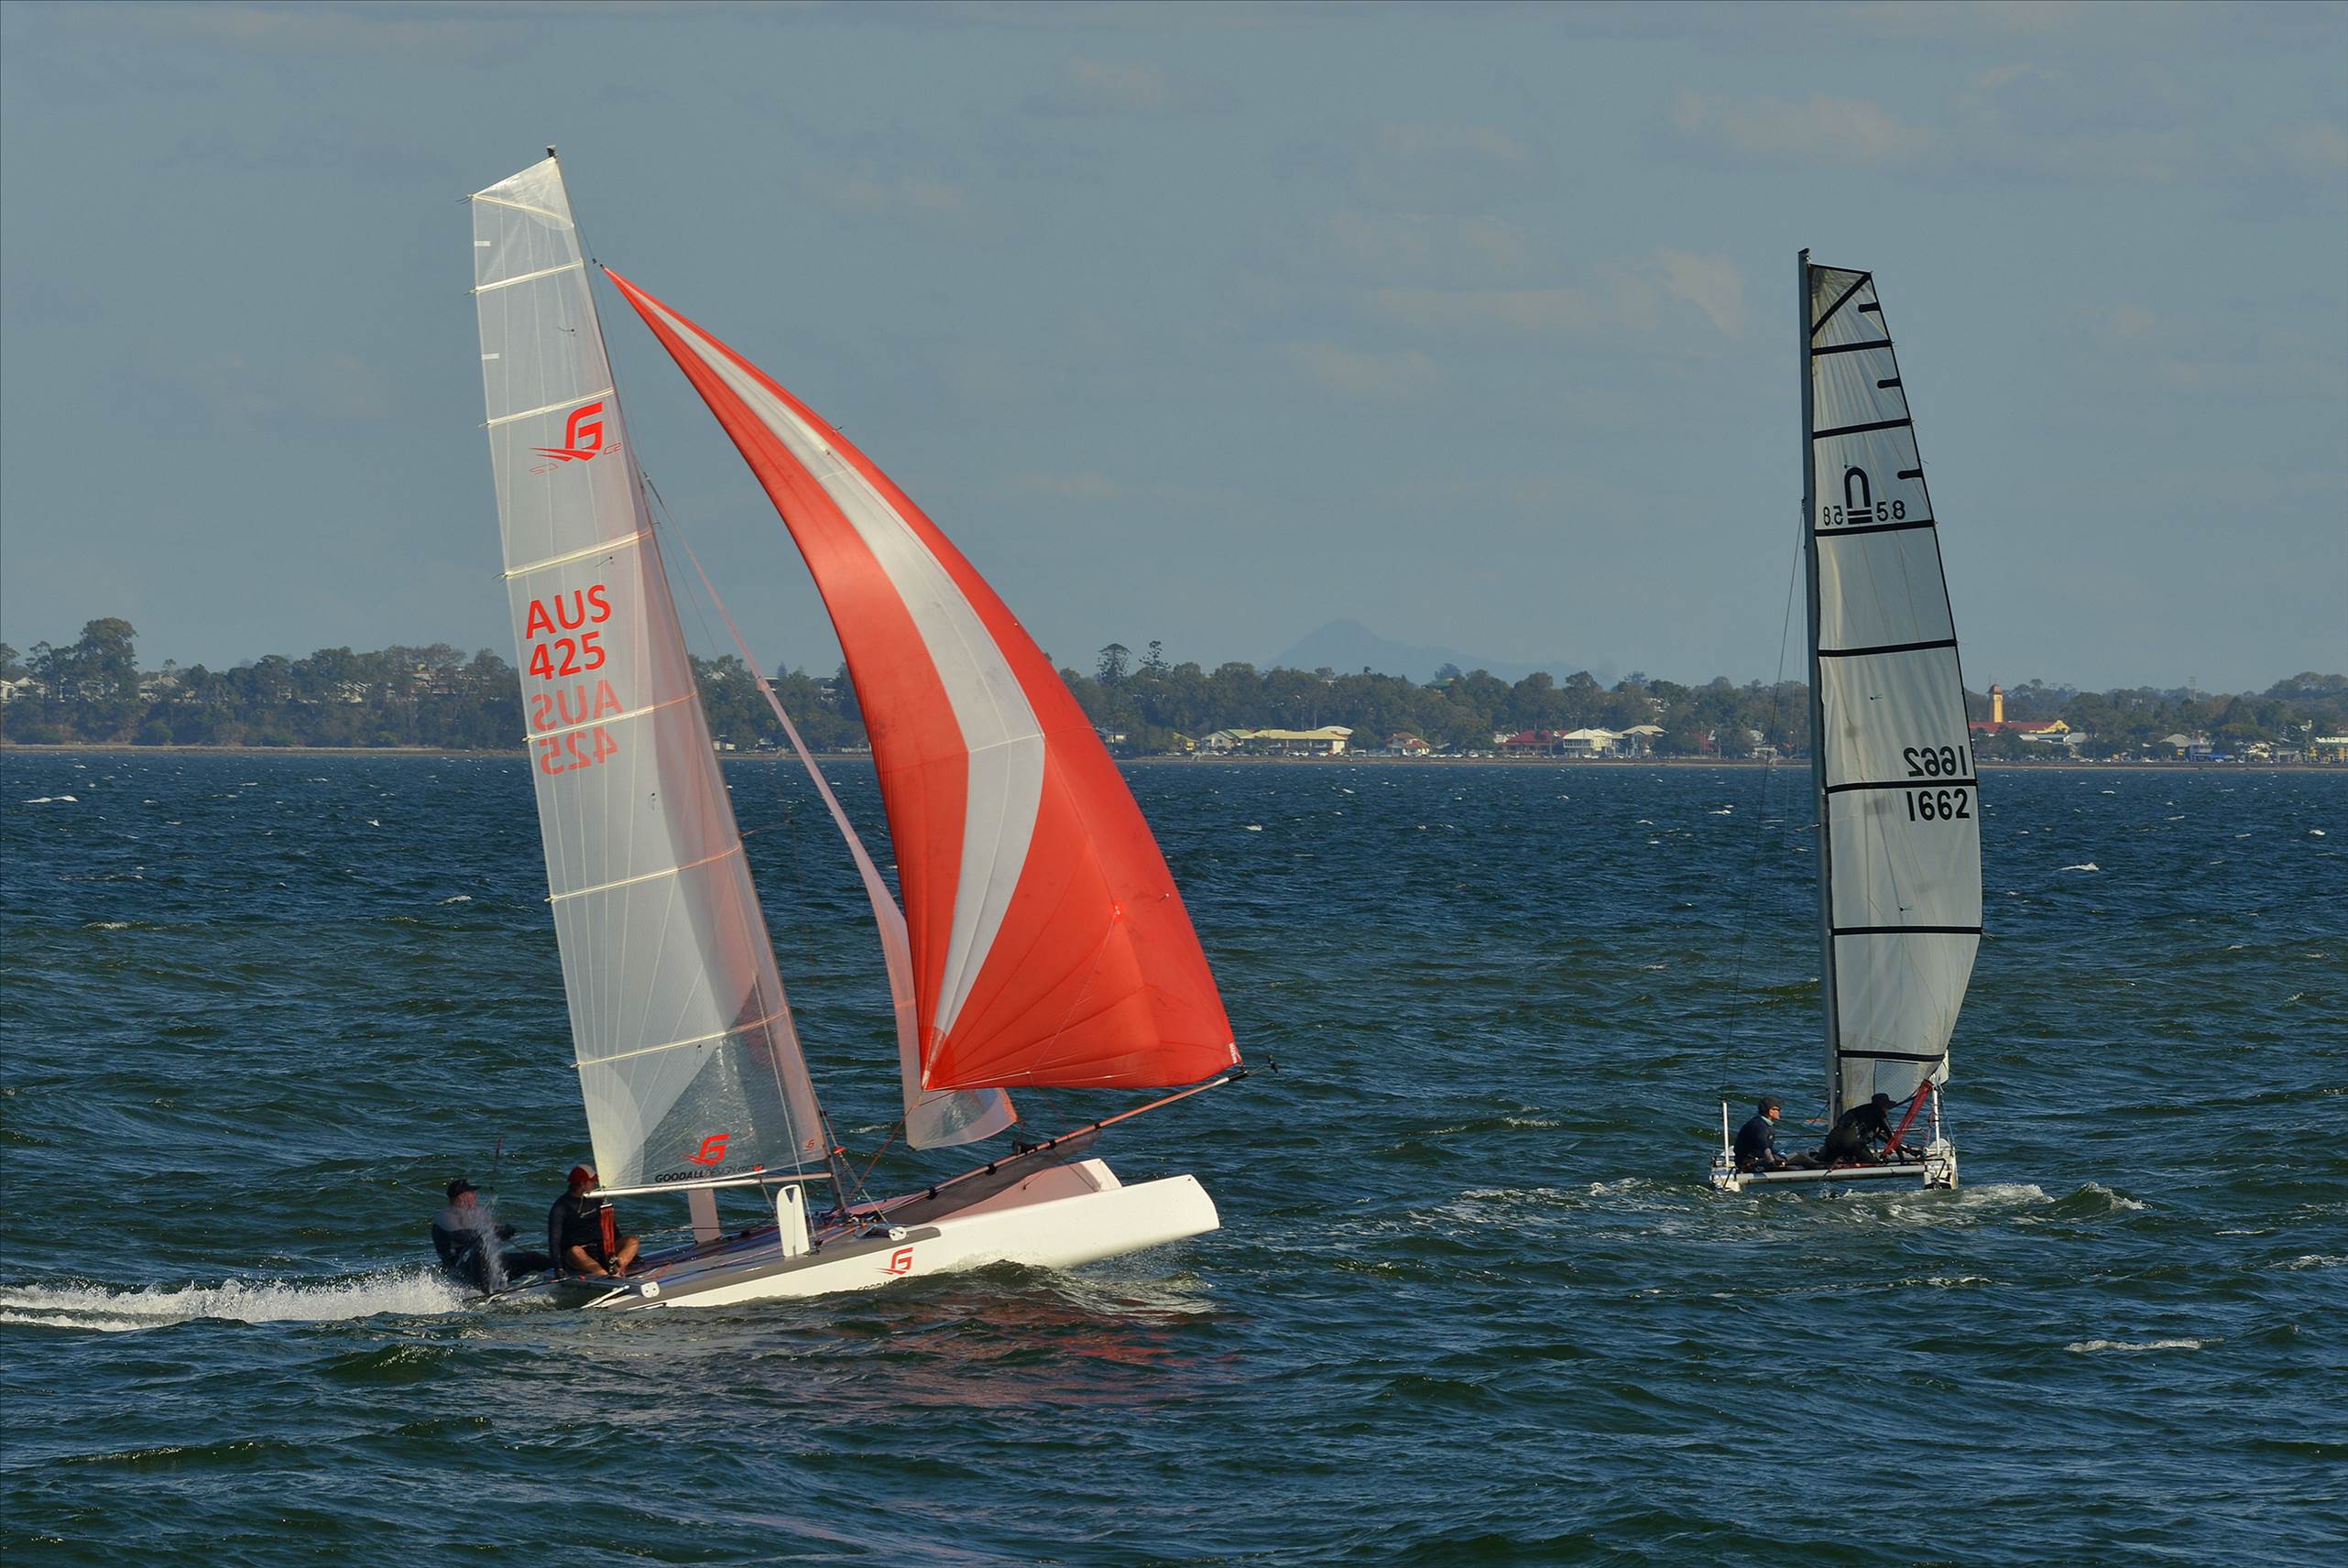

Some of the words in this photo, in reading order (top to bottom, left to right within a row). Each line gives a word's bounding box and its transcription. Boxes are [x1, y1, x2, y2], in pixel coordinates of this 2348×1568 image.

[1877, 500, 1906, 521] 5.8
[526, 584, 611, 639] AUS
[530, 631, 606, 680] 425
[1906, 789, 1970, 821] 1662
